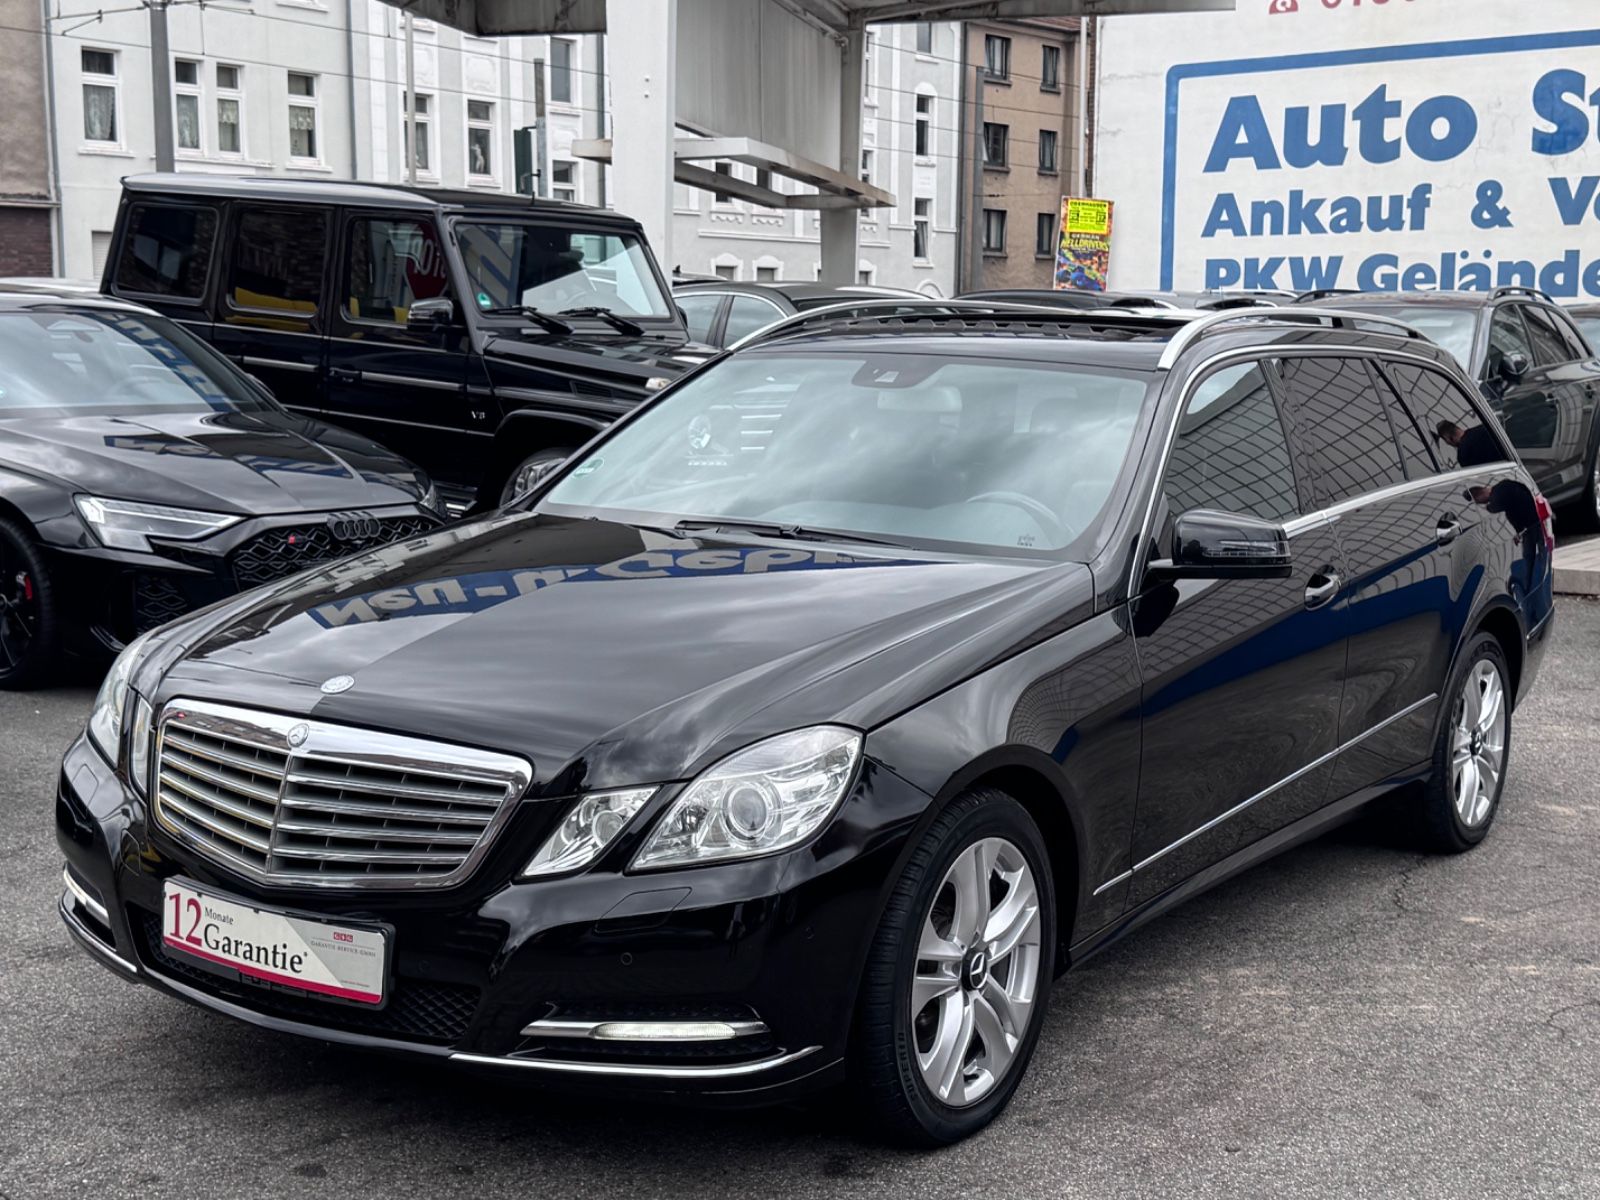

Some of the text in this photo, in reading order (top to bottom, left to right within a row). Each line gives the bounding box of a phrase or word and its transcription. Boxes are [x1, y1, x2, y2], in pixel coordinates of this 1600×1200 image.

[1203, 68, 1600, 173] Auto S
[1201, 176, 1600, 237] Ankauf & V
[1205, 256, 1343, 290] PKW
[169, 892, 203, 947] 12
[204, 906, 234, 925] Monate
[204, 923, 304, 974] Garantie
